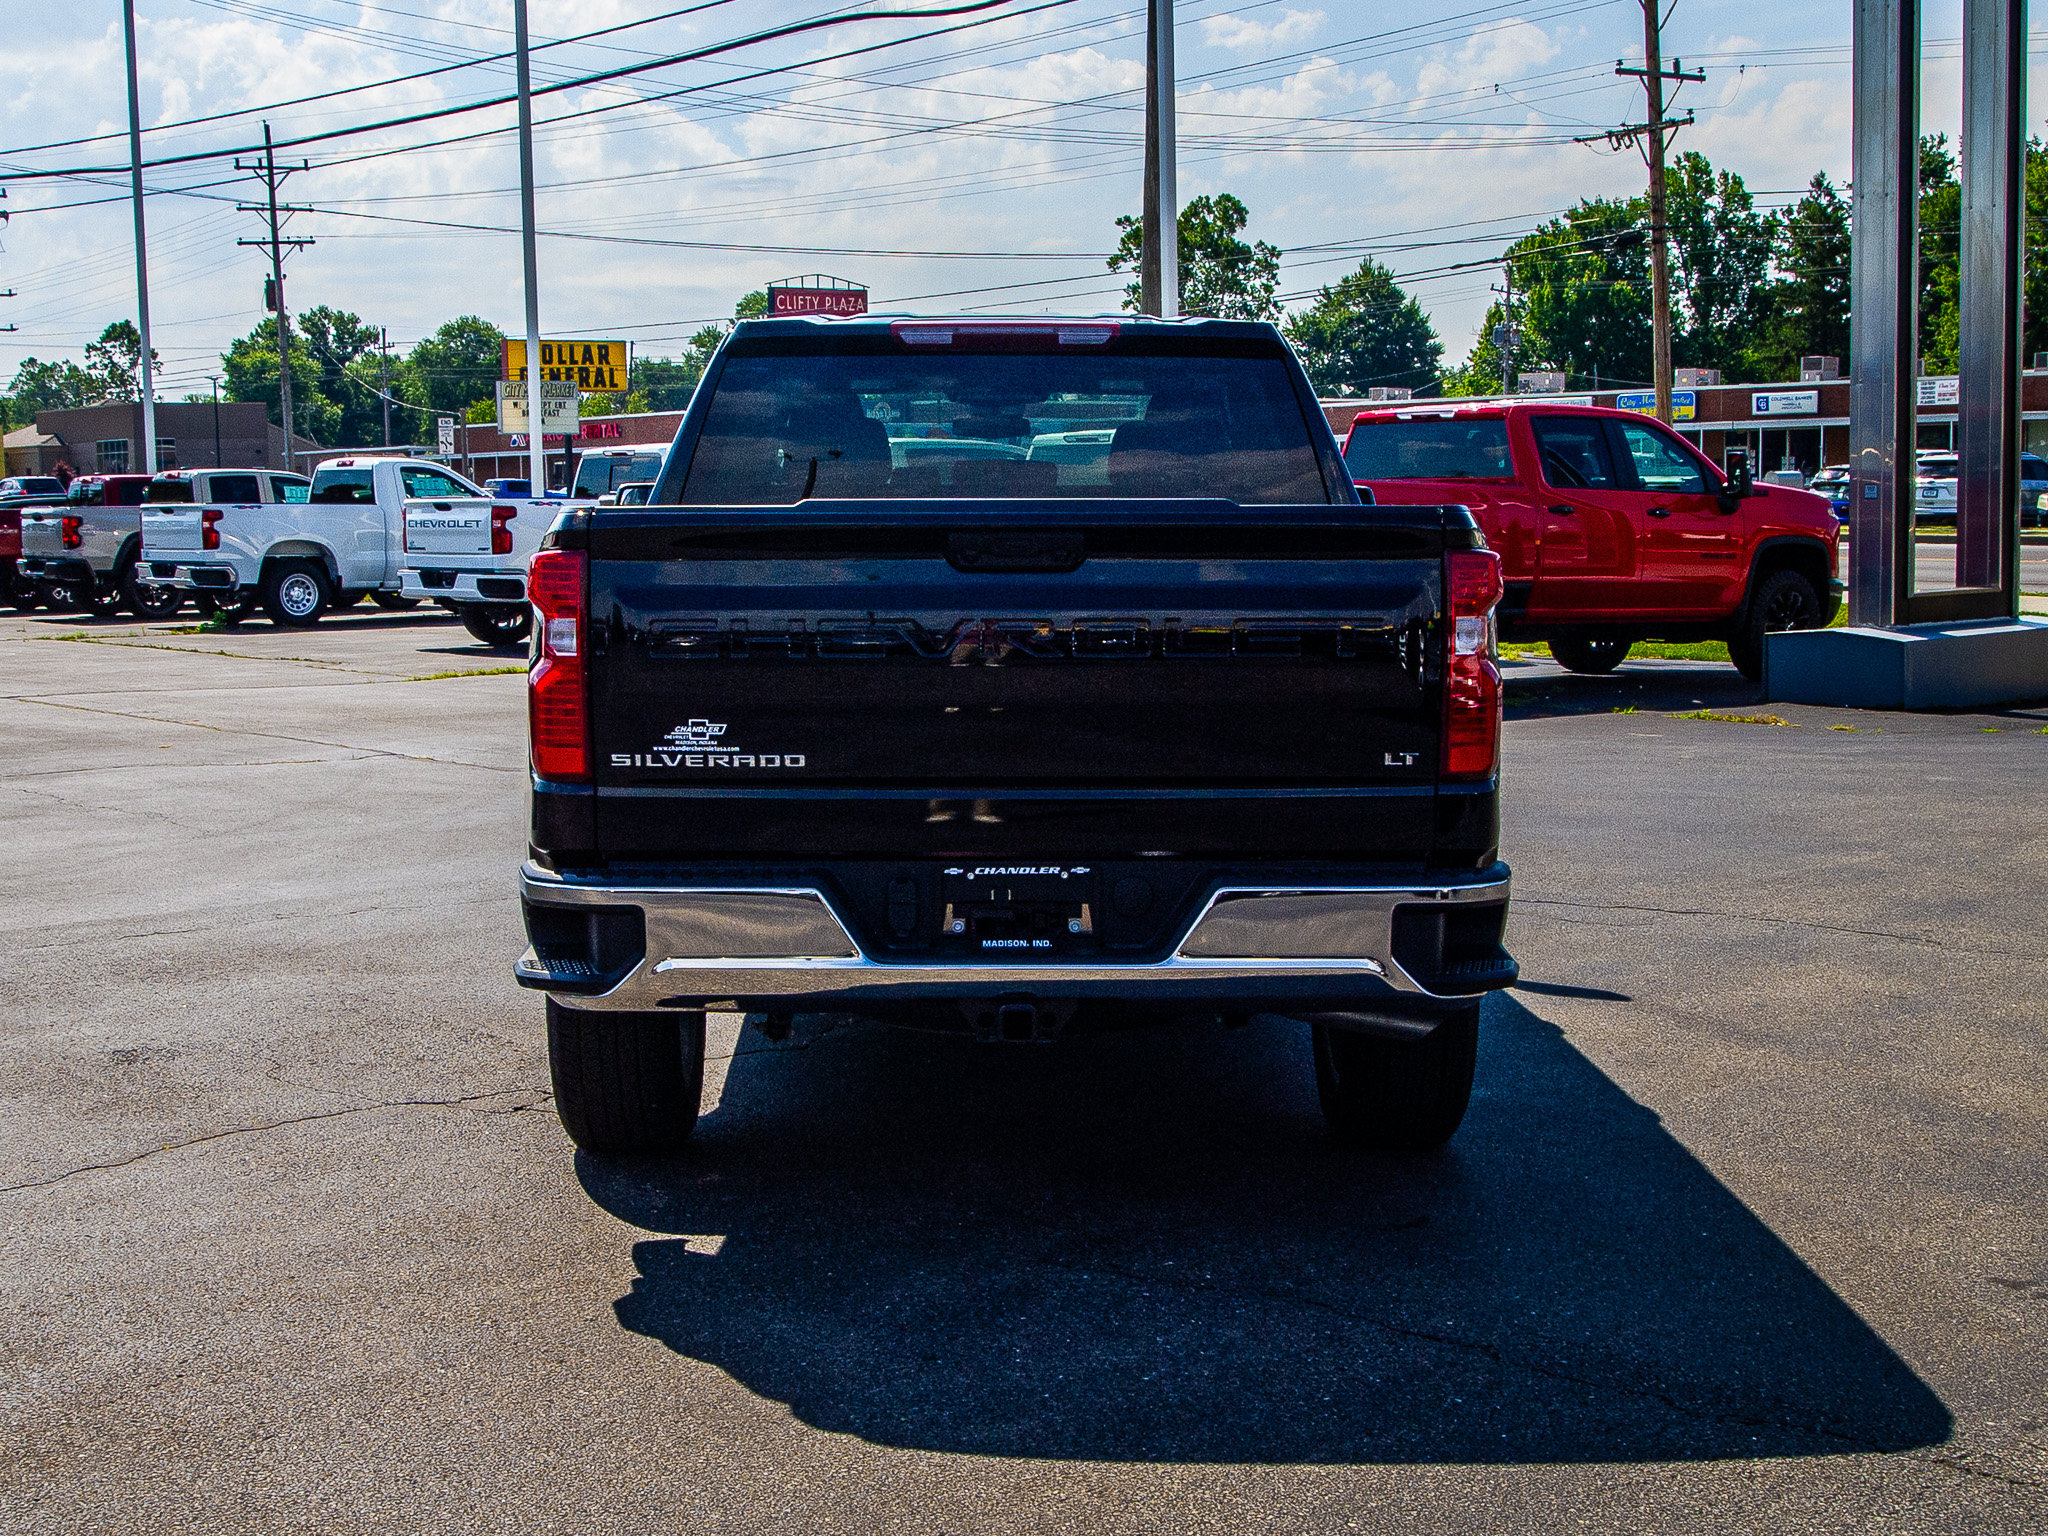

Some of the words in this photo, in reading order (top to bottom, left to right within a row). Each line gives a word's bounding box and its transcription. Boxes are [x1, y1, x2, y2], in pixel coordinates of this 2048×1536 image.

[776, 294, 819, 311] CLIFTY
[825, 296, 865, 312] PLAZA
[525, 344, 610, 365] OLLAR
[408, 519, 483, 529] CHEVROLET
[674, 725, 720, 734] CHANDLER
[610, 753, 807, 768] SILVERADO
[1384, 752, 1420, 766] LT
[974, 867, 1061, 875] CHANDLER
[1032, 939, 1053, 948] IND.
